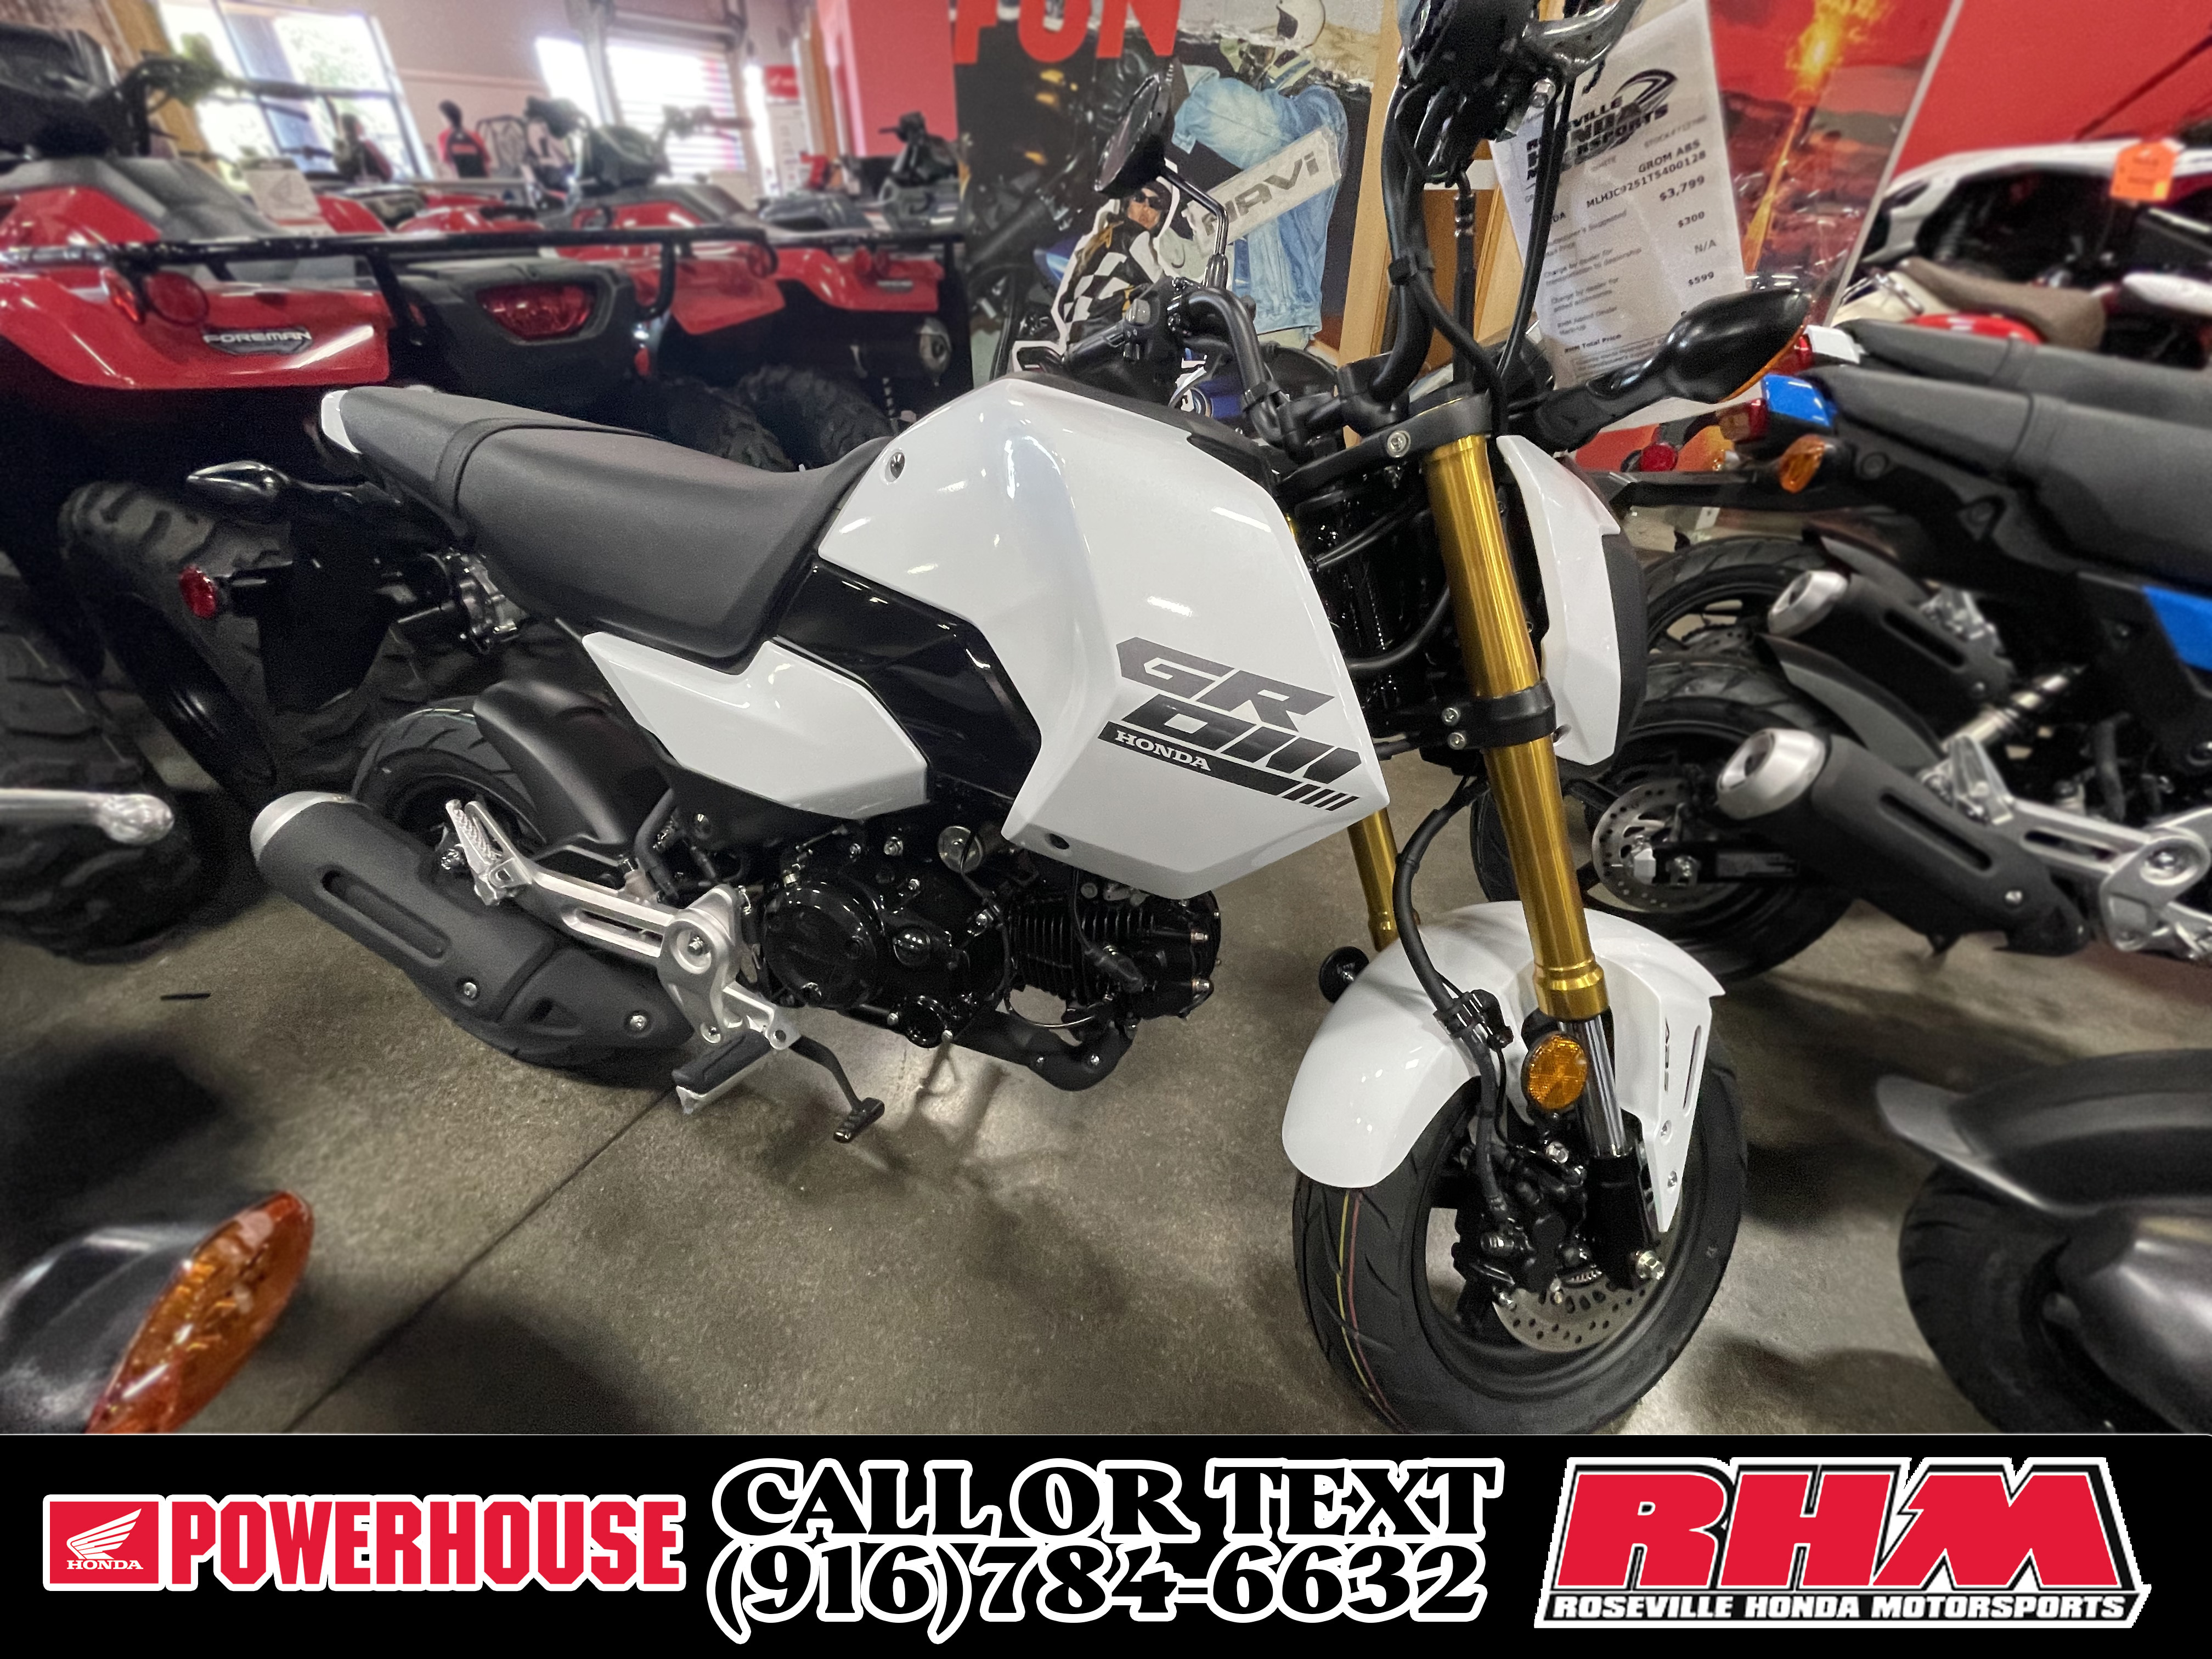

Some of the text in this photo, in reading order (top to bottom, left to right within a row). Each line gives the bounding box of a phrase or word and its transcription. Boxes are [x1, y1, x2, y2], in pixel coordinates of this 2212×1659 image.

[953, 0, 1181, 64] FUN
[1639, 152, 1673, 173] GROM
[1676, 139, 1700, 157] ABS
[1659, 174, 1705, 202] $3,799
[1678, 211, 1705, 228] $300
[1694, 239, 1717, 254] N/A
[1688, 271, 1714, 287] $599
[202, 331, 312, 343] FOREMAN
[1582, 339, 1600, 349] Total
[1601, 334, 1622, 343] Price
[1114, 729, 1211, 771] HONDA
